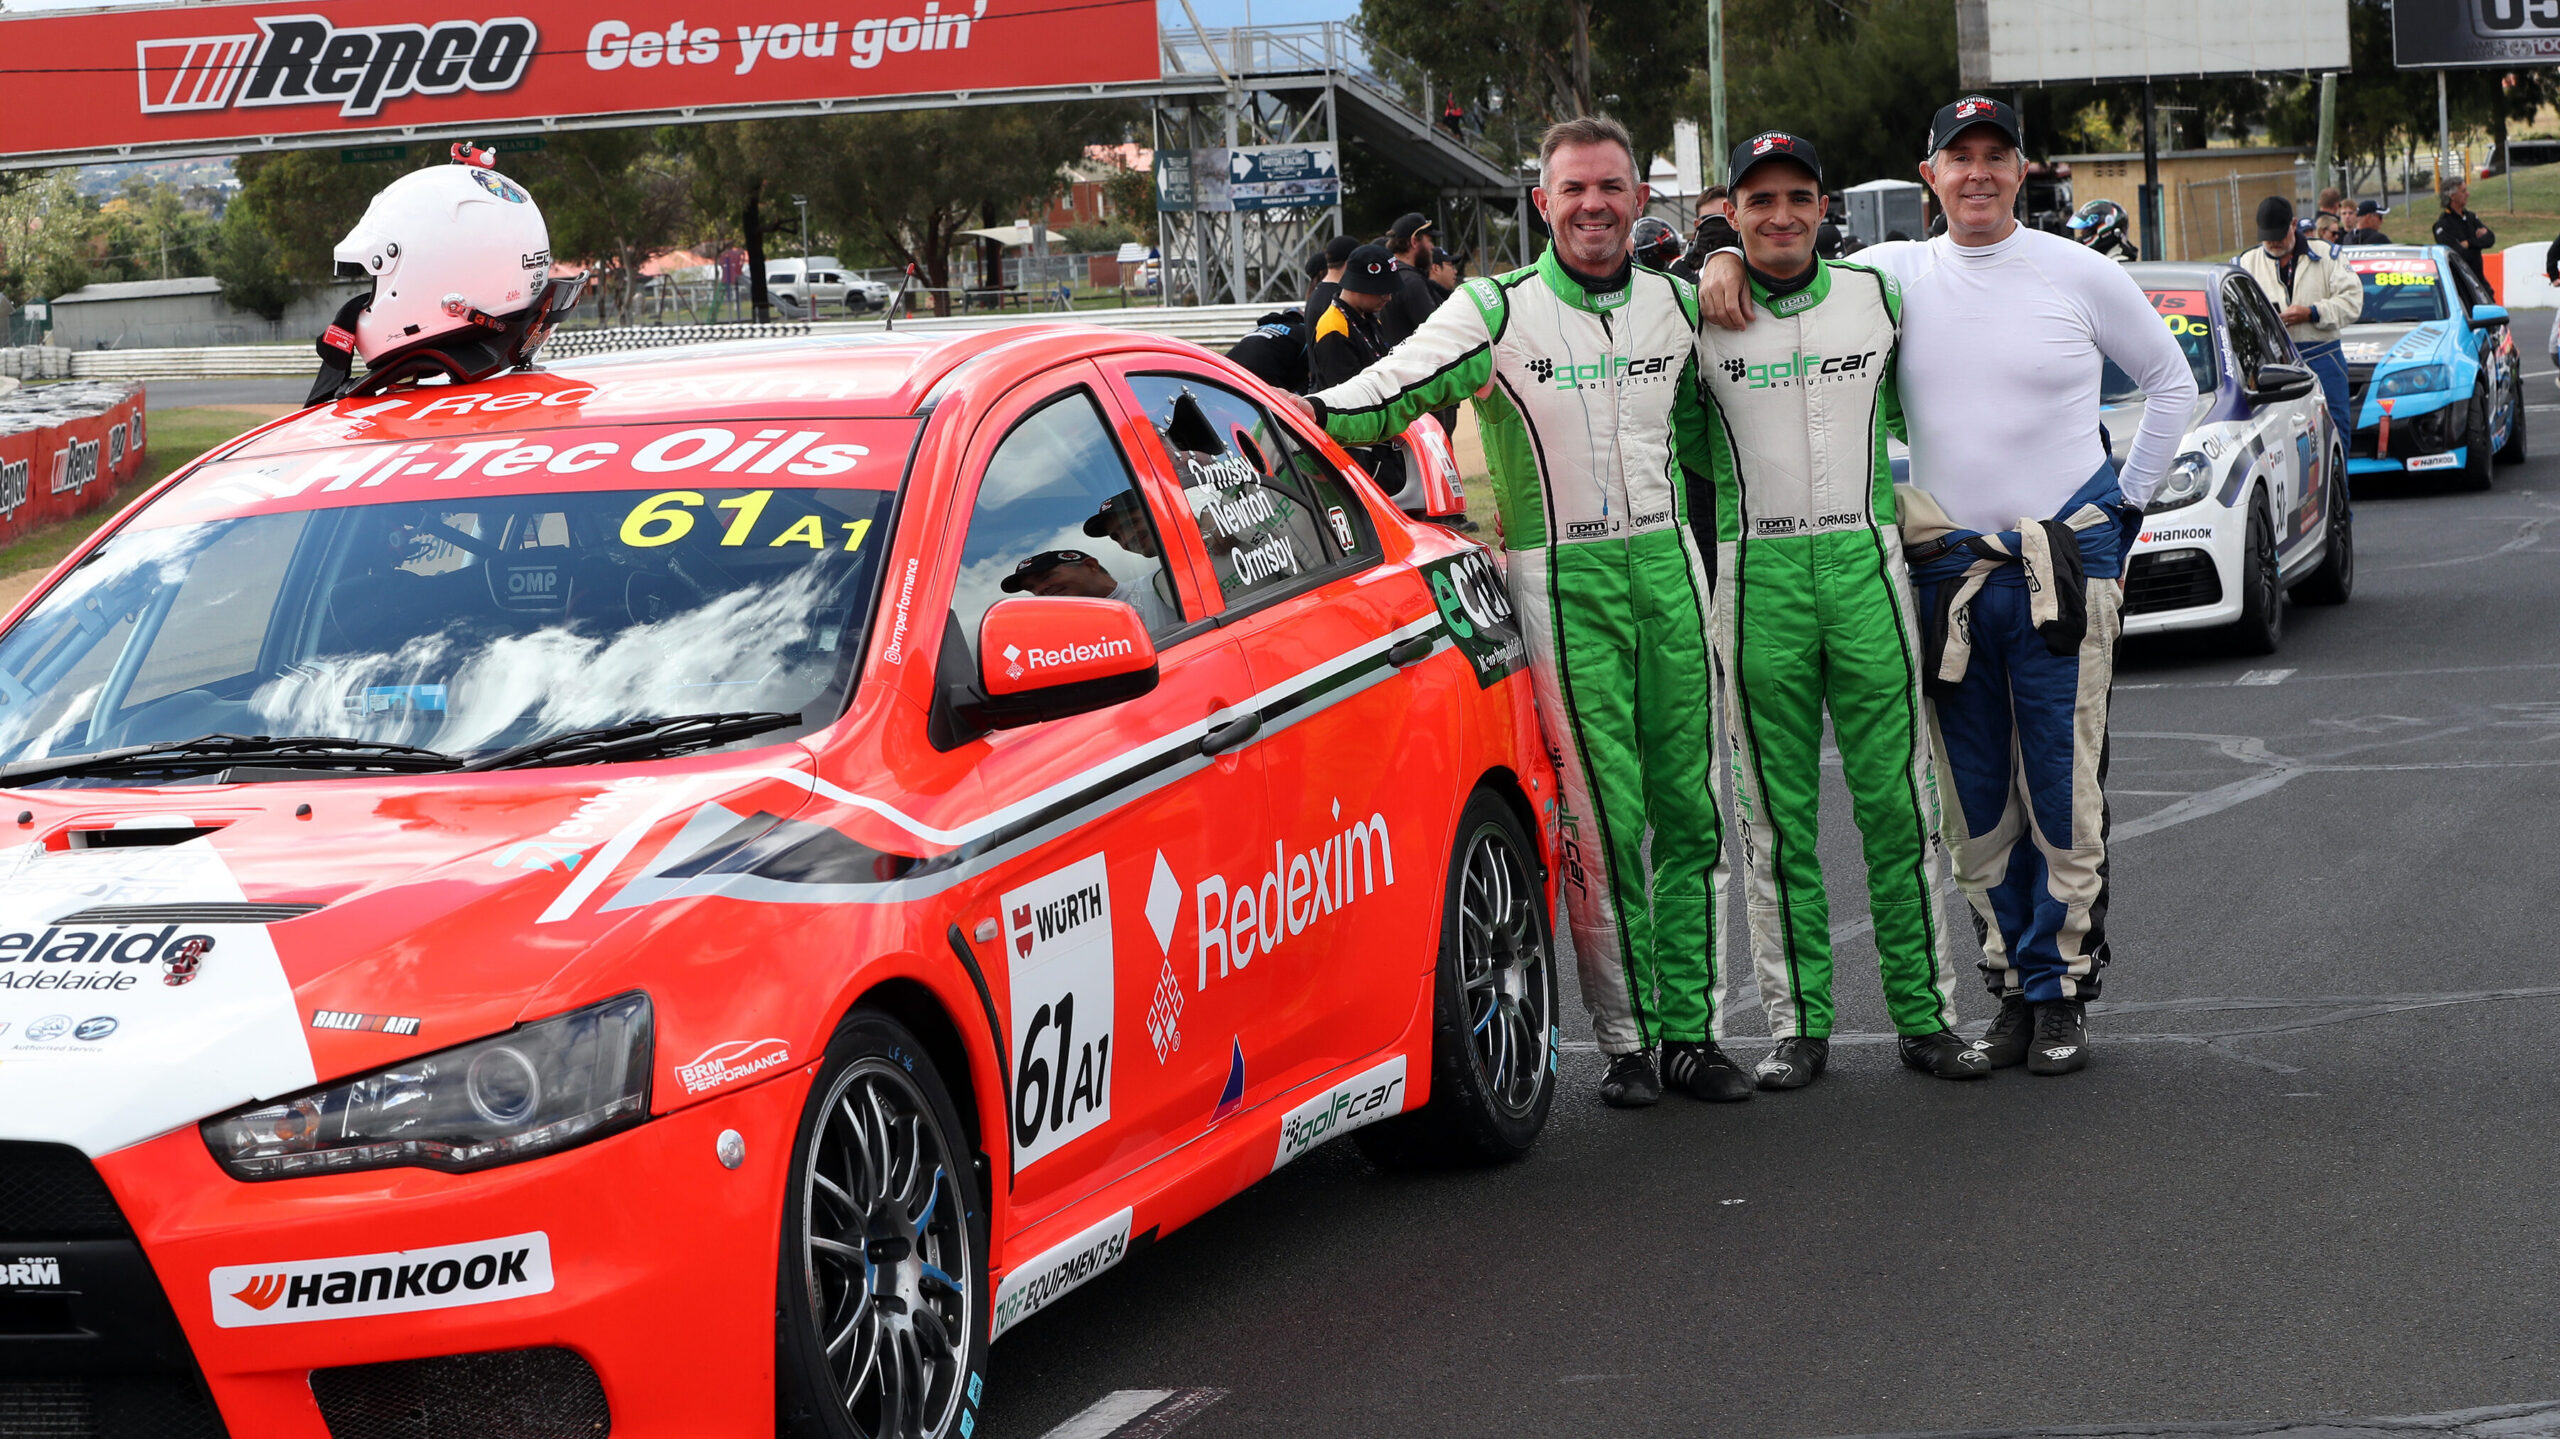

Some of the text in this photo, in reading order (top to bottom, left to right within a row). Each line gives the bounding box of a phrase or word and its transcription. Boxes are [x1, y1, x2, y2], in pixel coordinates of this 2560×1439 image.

[242, 17, 534, 113] Repco
[586, 19, 720, 71] Gets
[735, 21, 839, 76] you
[1956, 96, 1994, 108] BATHURST
[1753, 132, 1791, 145] BATHURST
[2369, 260, 2427, 272] Oils
[2374, 272, 2435, 286] 888A2
[2144, 292, 2188, 309] ls
[1747, 350, 1876, 389] golfcar
[66, 437, 99, 495] Repco
[272, 427, 870, 499] Hi-Tec Oils
[1187, 455, 1262, 494] Ormsby
[1207, 489, 1275, 539] Newton
[1569, 522, 1605, 533] rpm
[1635, 510, 1670, 528] ORMSBY
[1759, 518, 1792, 529] rpm
[1818, 512, 1862, 527] ORMSBY
[1231, 532, 1298, 587] Ormsby
[508, 572, 557, 594] OMP
[1027, 635, 1133, 670] Redexim
[1036, 882, 1103, 943] WÜRTH
[1195, 797, 1395, 992] Redexim
[0, 970, 137, 991] Adelaide
[681, 1058, 726, 1084] BRM
[685, 1049, 790, 1095] PERFORMANCE
[1023, 1238, 1112, 1310] EQUIPMENT
